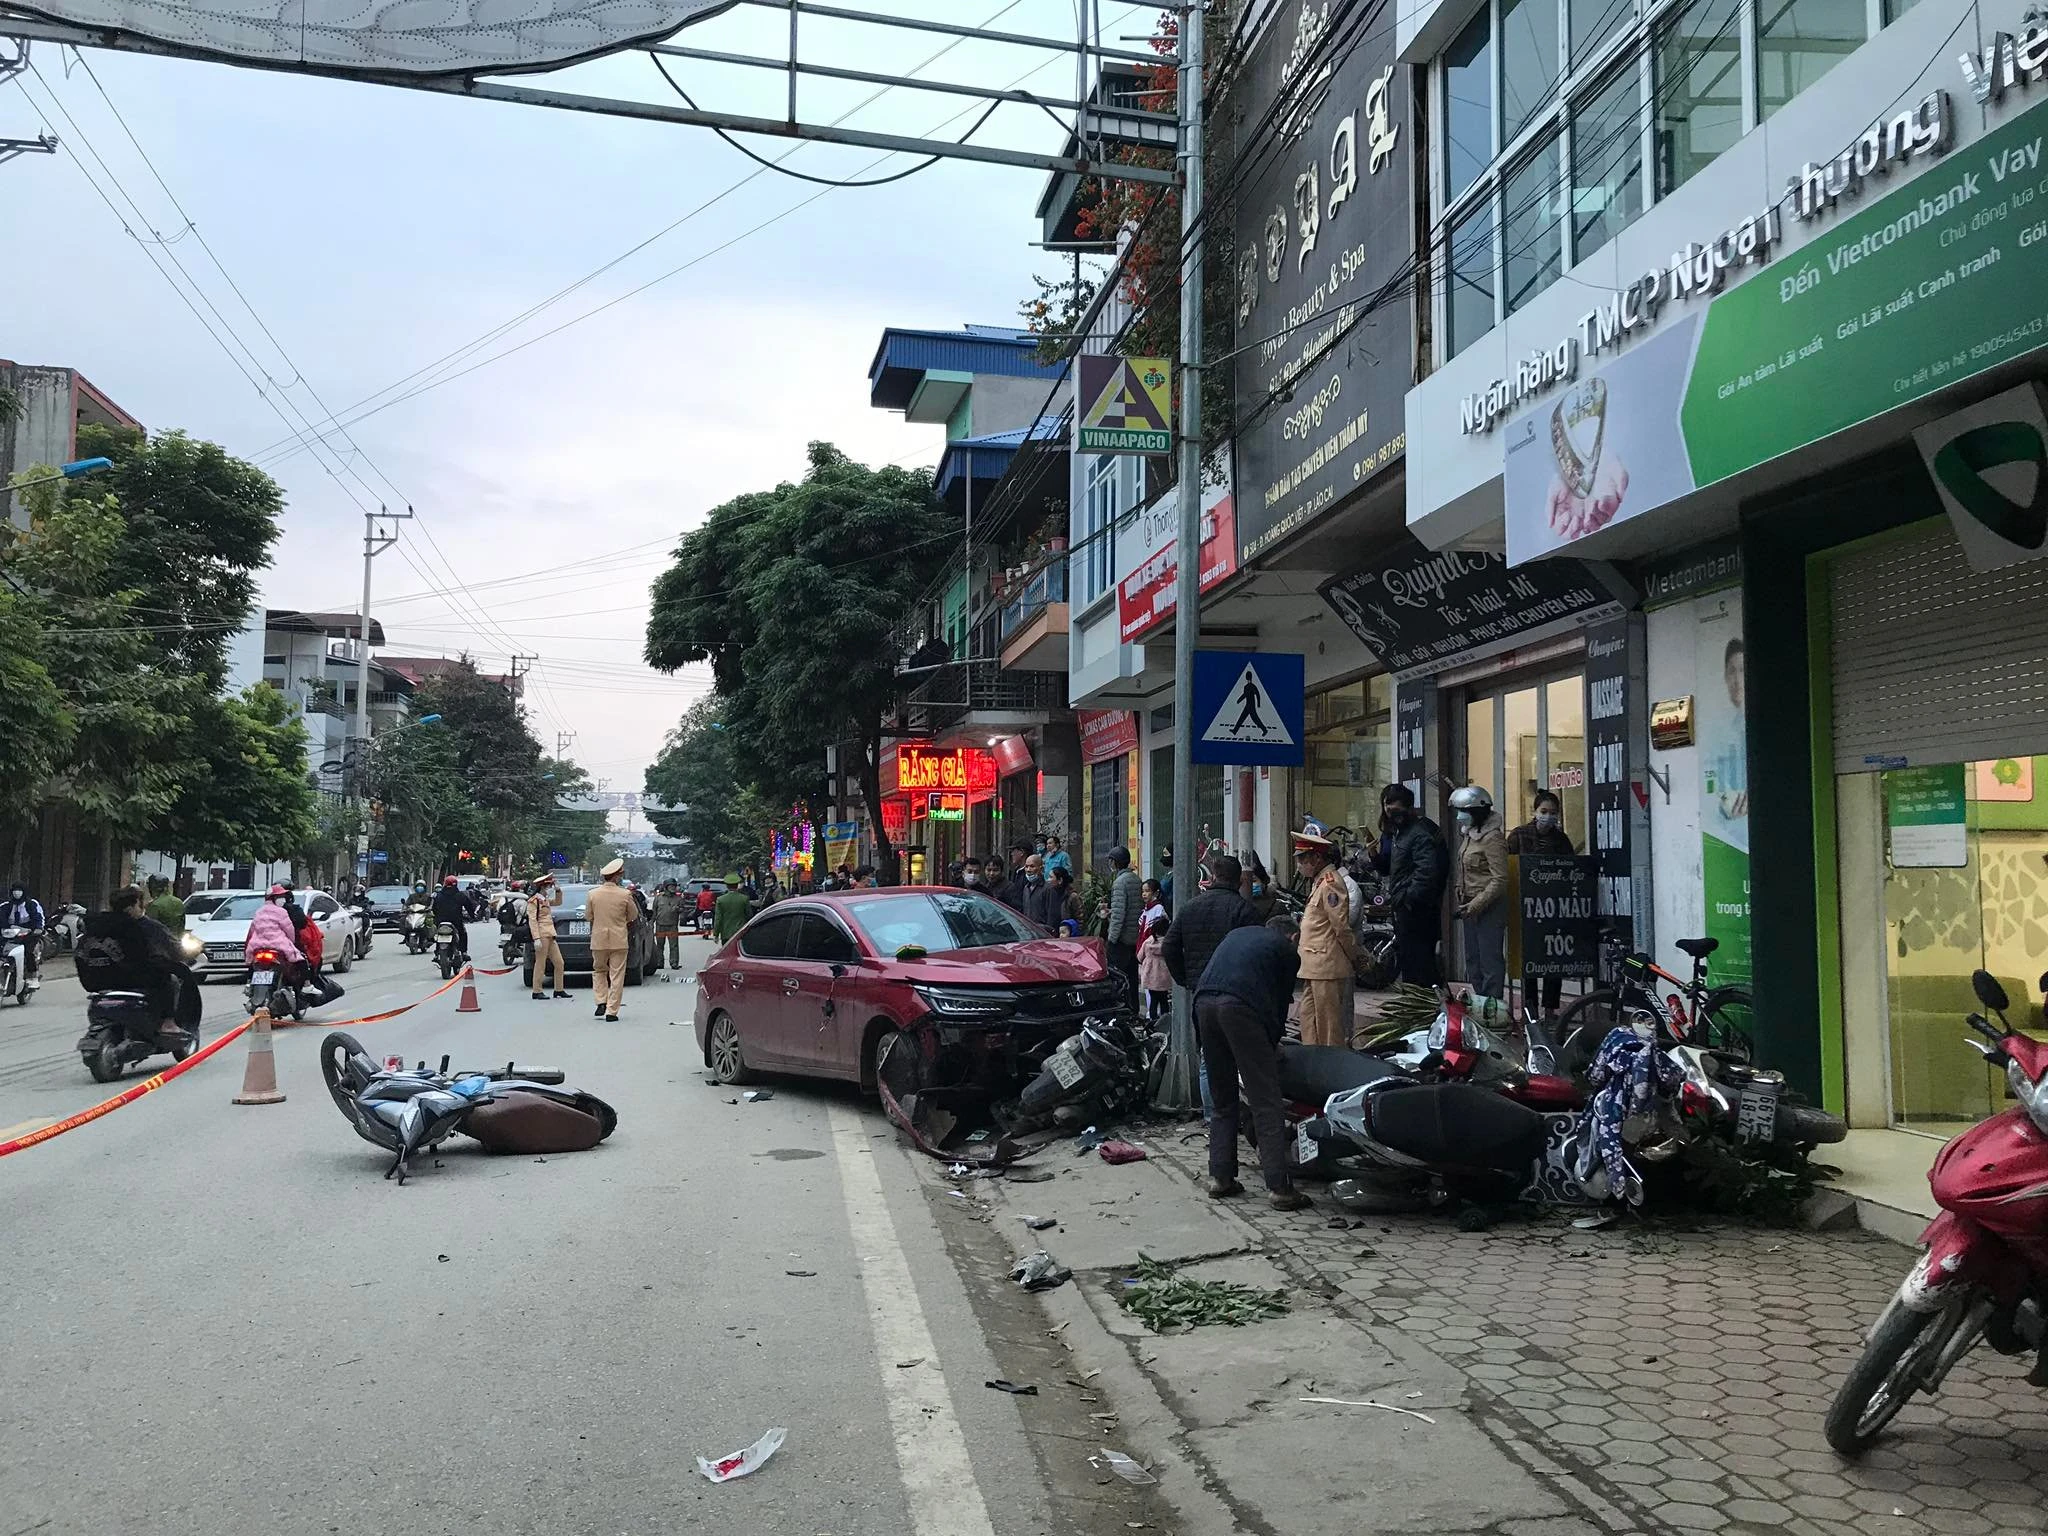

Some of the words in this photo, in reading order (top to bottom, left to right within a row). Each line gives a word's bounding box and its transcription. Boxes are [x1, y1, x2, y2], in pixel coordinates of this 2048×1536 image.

[1779, 260, 1820, 303] Đến
[1827, 172, 1981, 275] Vietcombank
[1989, 137, 2042, 182] Vay
[1460, 378, 1511, 434] Ngân
[1516, 337, 1575, 399] hàng
[1577, 269, 1665, 356] TMCP
[1671, 205, 1780, 299] Ngoại
[1784, 89, 1946, 222] thương
[1289, 282, 1327, 336] Beauty
[1328, 263, 1339, 295] &
[1341, 243, 1366, 283] Spa
[1837, 318, 1858, 339] Gói
[1862, 306, 1882, 328] Lãi
[1885, 287, 1914, 316] suất
[1918, 271, 1955, 298] Cạnh
[1959, 246, 2001, 278] tranh
[1737, 375, 1752, 391] An
[1798, 334, 1824, 360] suất
[1084, 431, 1166, 449] VINAAPACO
[1382, 549, 1469, 608] Quỳnh
[1437, 604, 1468, 627] Tóc
[1472, 622, 1501, 642] PHỤC
[1501, 611, 1521, 632] HỒI
[1520, 597, 1567, 624] CHUYÊN
[1568, 587, 1596, 607] SÂU
[900, 749, 939, 787] RĂNG
[941, 748, 967, 787] GIẢ
[1524, 897, 1555, 923] TẠO
[1558, 886, 1592, 919] MẪU
[1716, 901, 1743, 917] trong
[1544, 929, 1575, 957] TÓC
